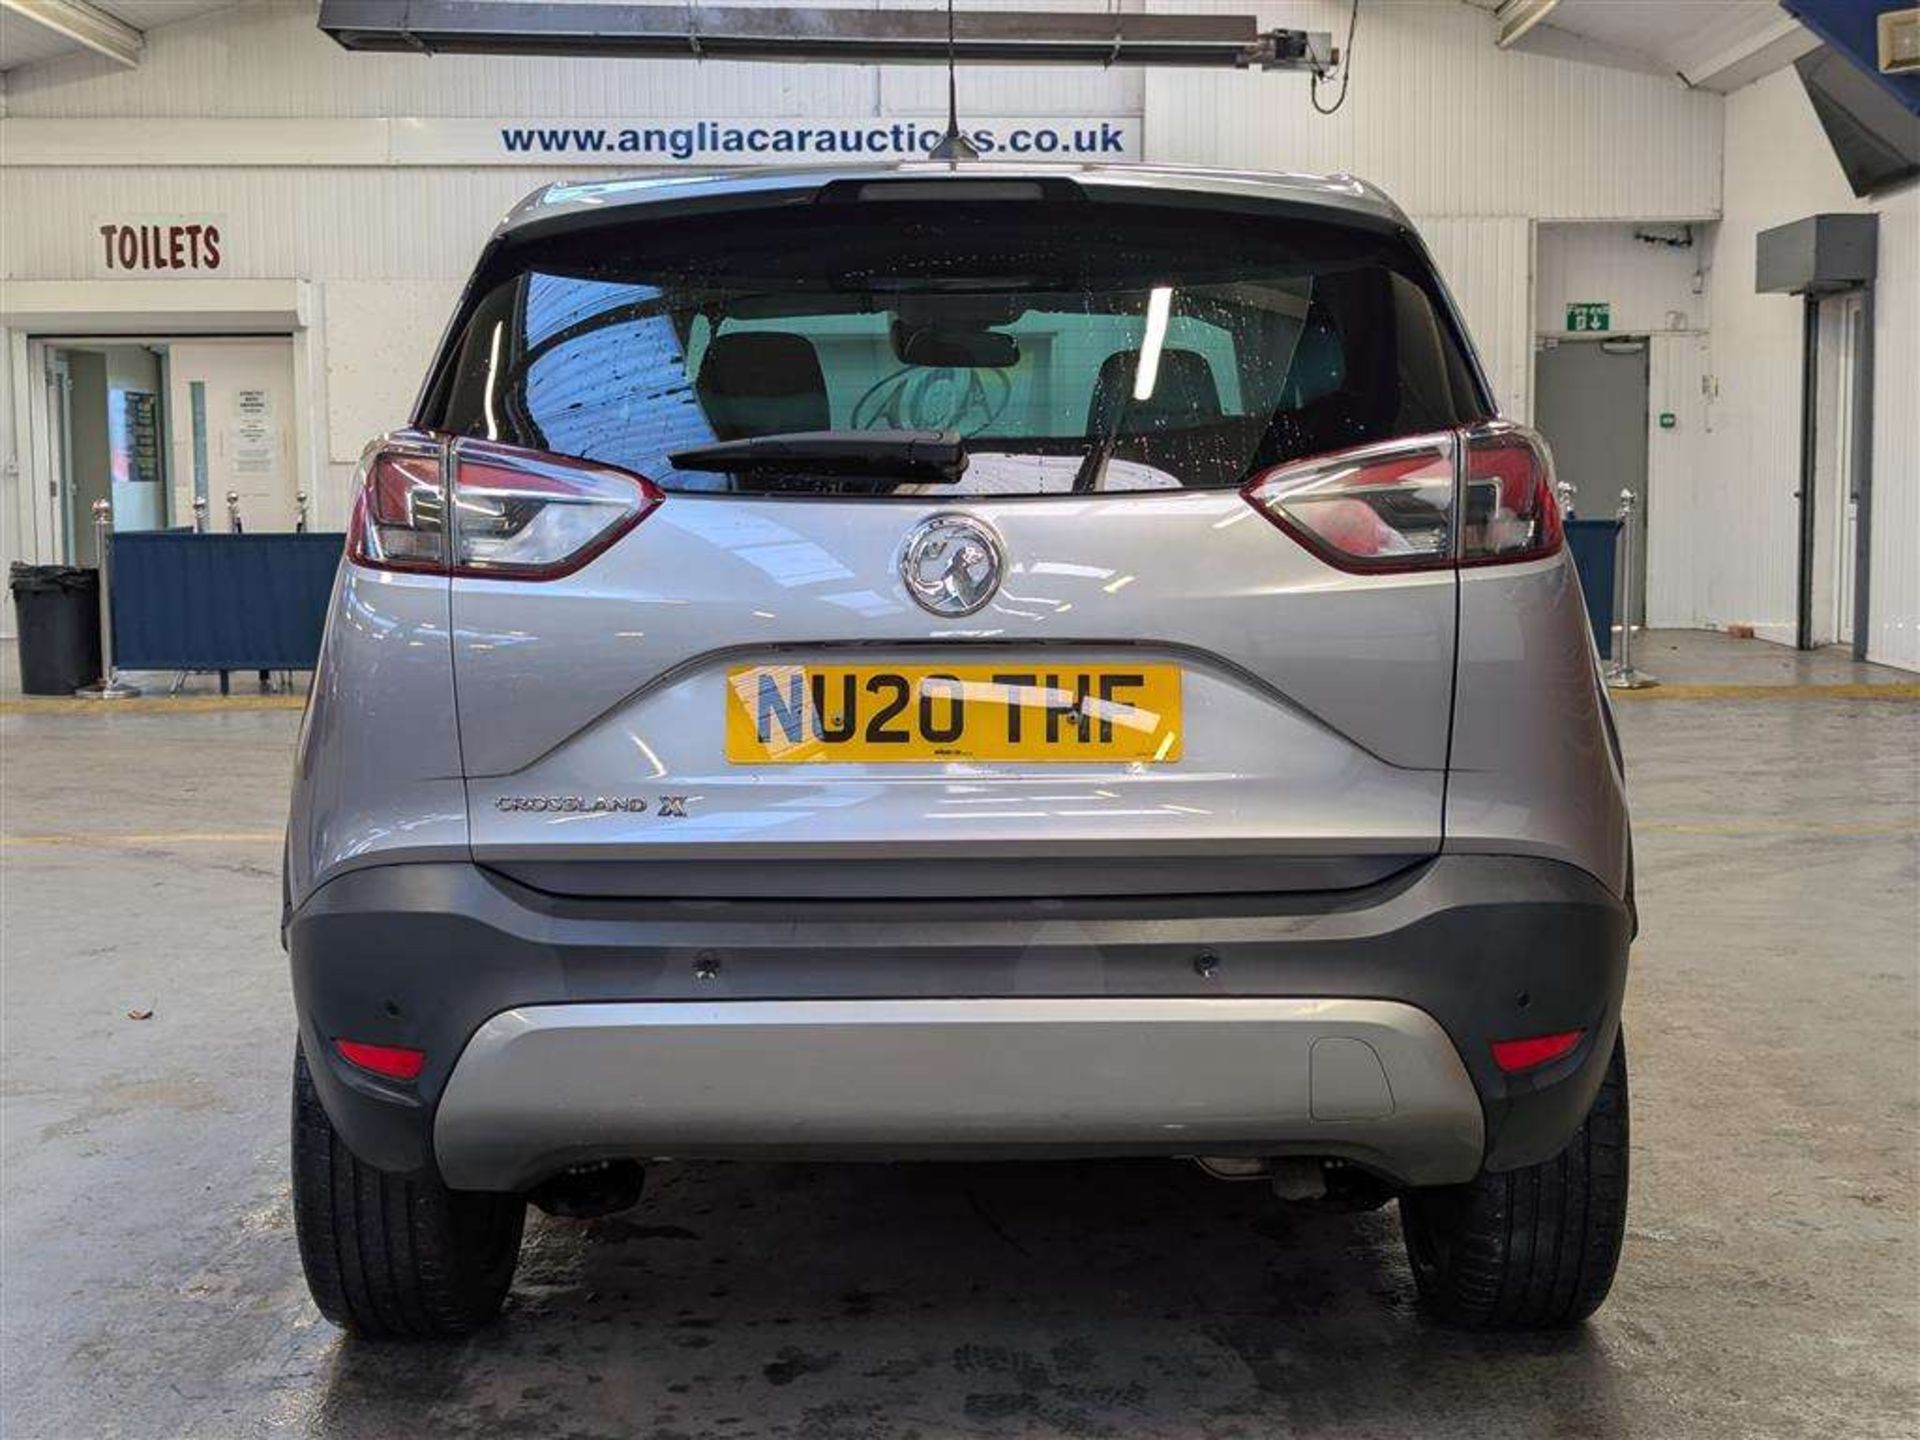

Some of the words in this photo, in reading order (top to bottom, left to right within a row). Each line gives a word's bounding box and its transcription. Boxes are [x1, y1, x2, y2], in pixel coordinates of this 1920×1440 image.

[501, 122, 1124, 159] www.angliacarauctios.co.uk
[100, 224, 221, 270] TOILETS
[758, 674, 964, 743] NU20
[992, 674, 1144, 743] THF
[495, 796, 648, 813] CROSSLAND
[657, 795, 688, 817] X
